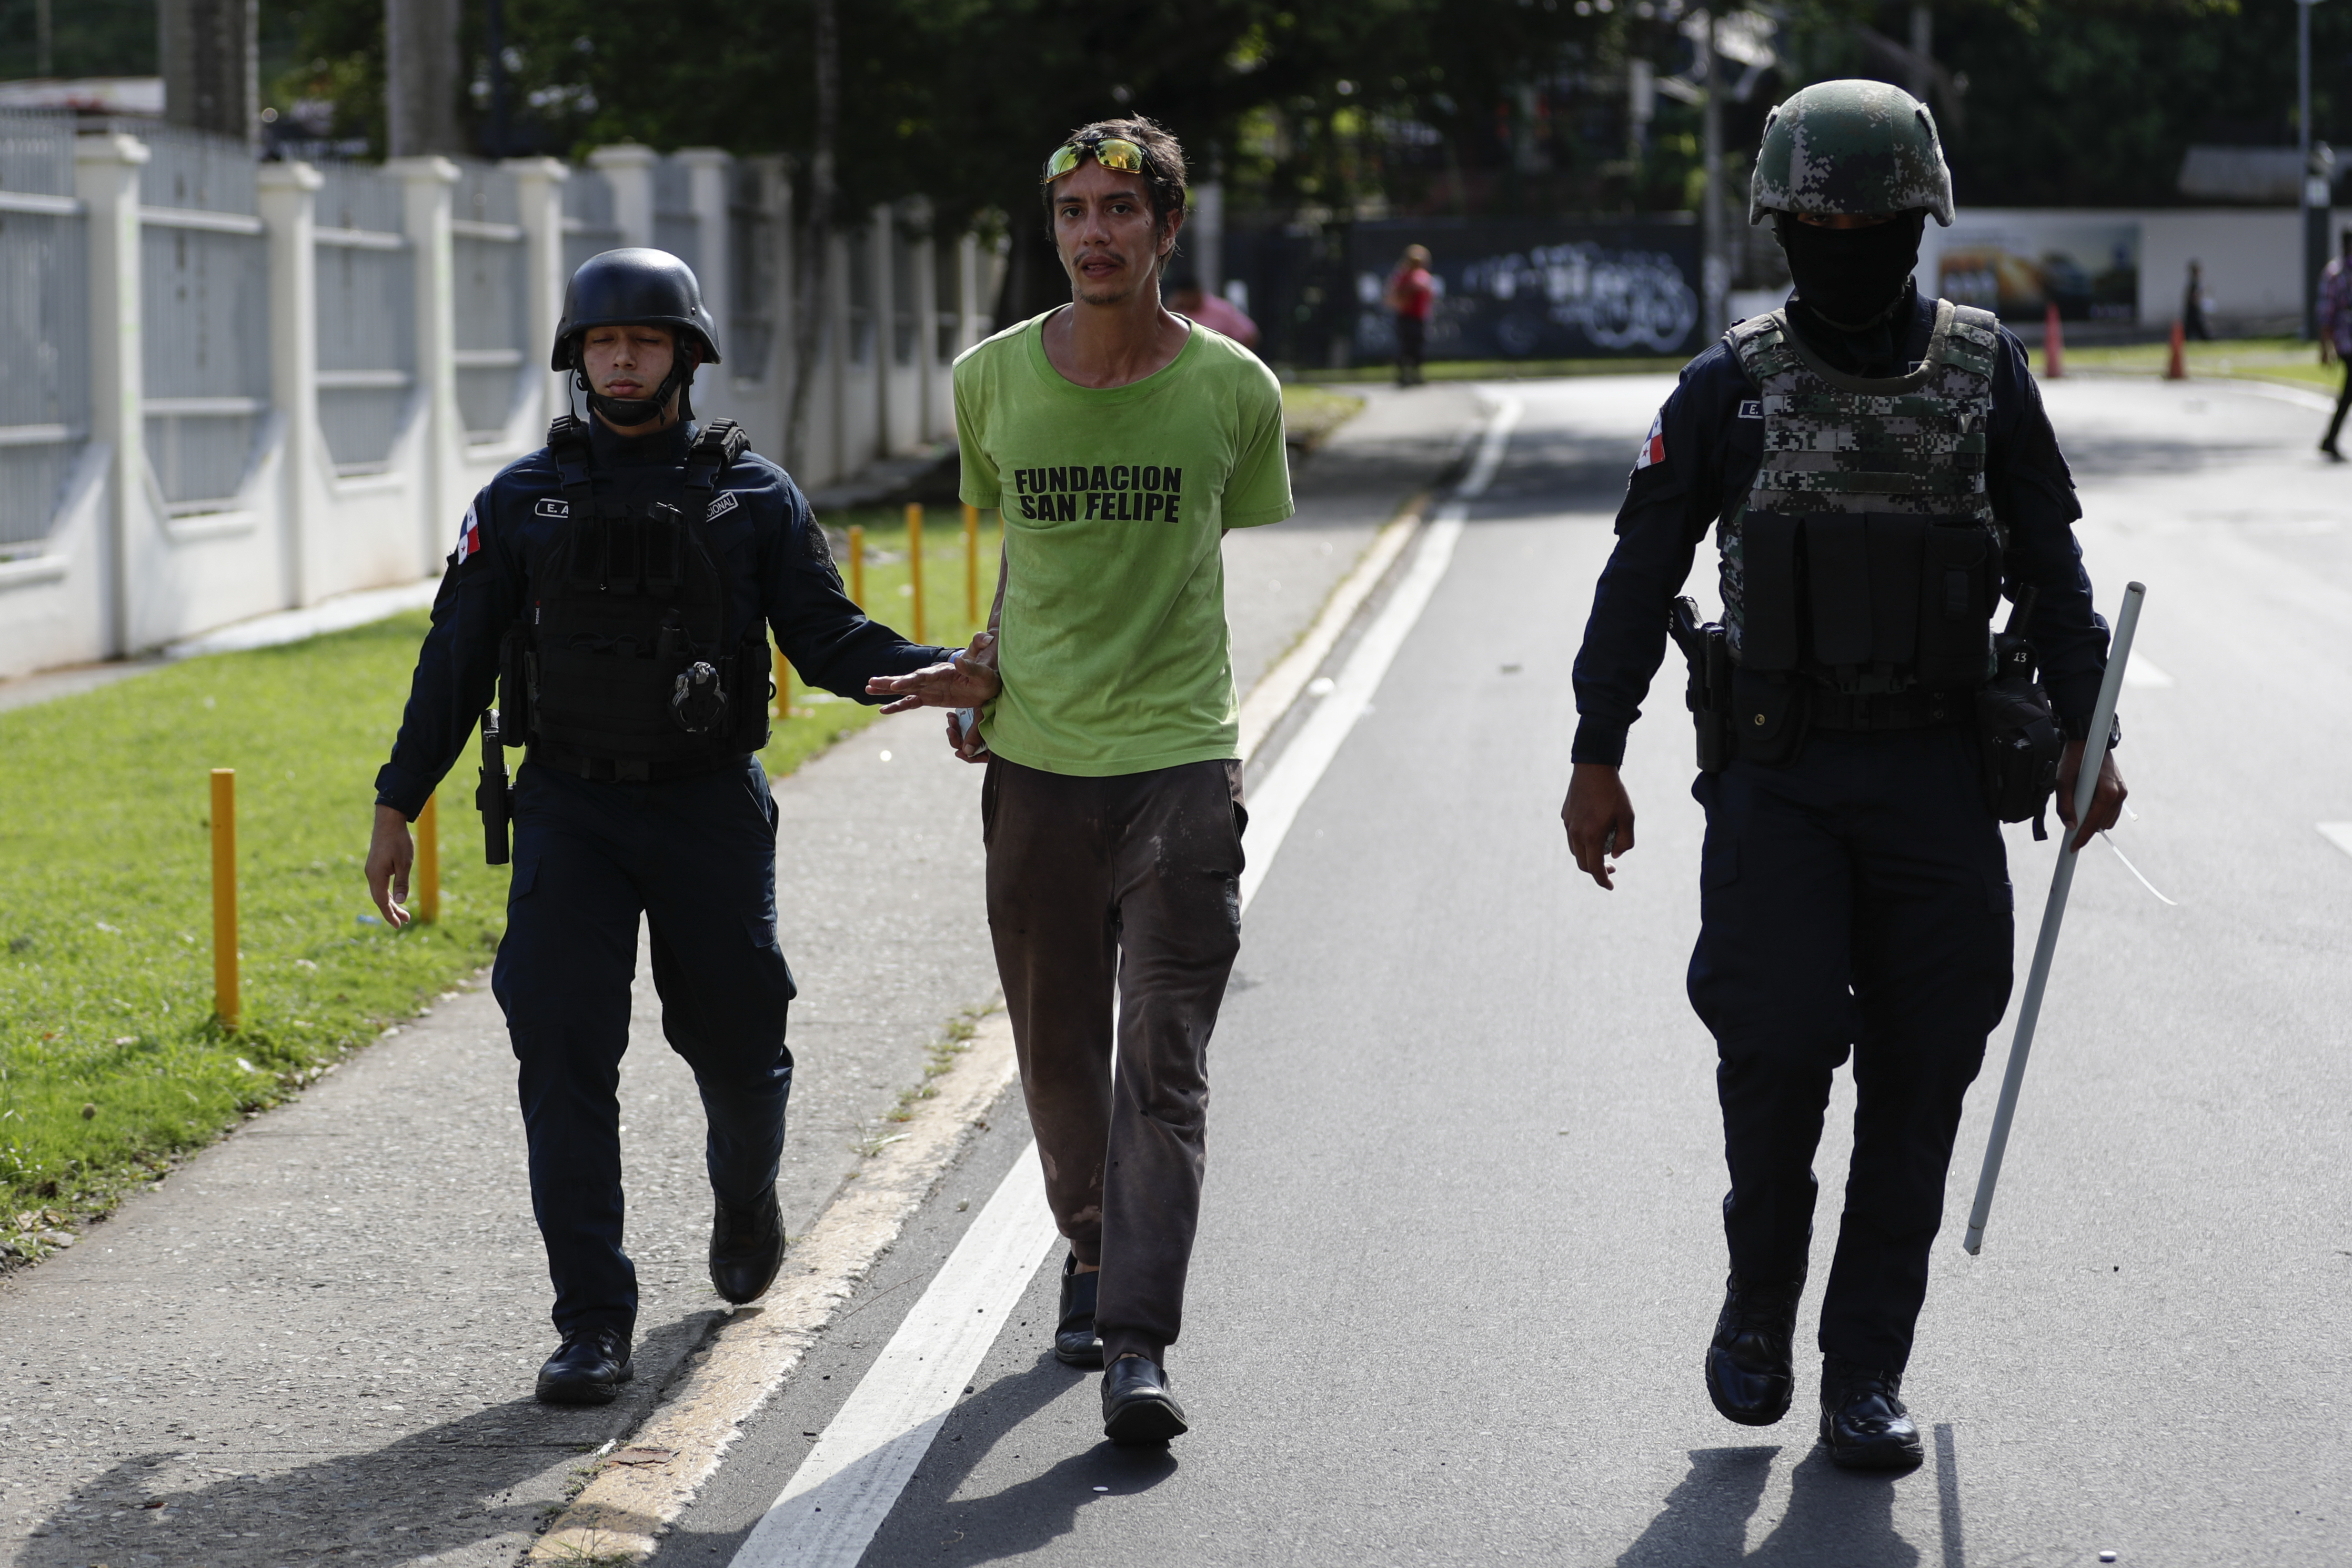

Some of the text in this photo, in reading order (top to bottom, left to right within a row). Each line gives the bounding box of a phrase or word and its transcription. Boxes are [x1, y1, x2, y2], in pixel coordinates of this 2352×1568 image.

[1749, 404, 1758, 415] E.
[1014, 465, 1182, 494] FUNDACION
[547, 504, 558, 513] E.
[706, 497, 735, 518] CIONAL
[1019, 492, 1181, 523] SAN FELIPE
[2013, 652, 2027, 662] 13
